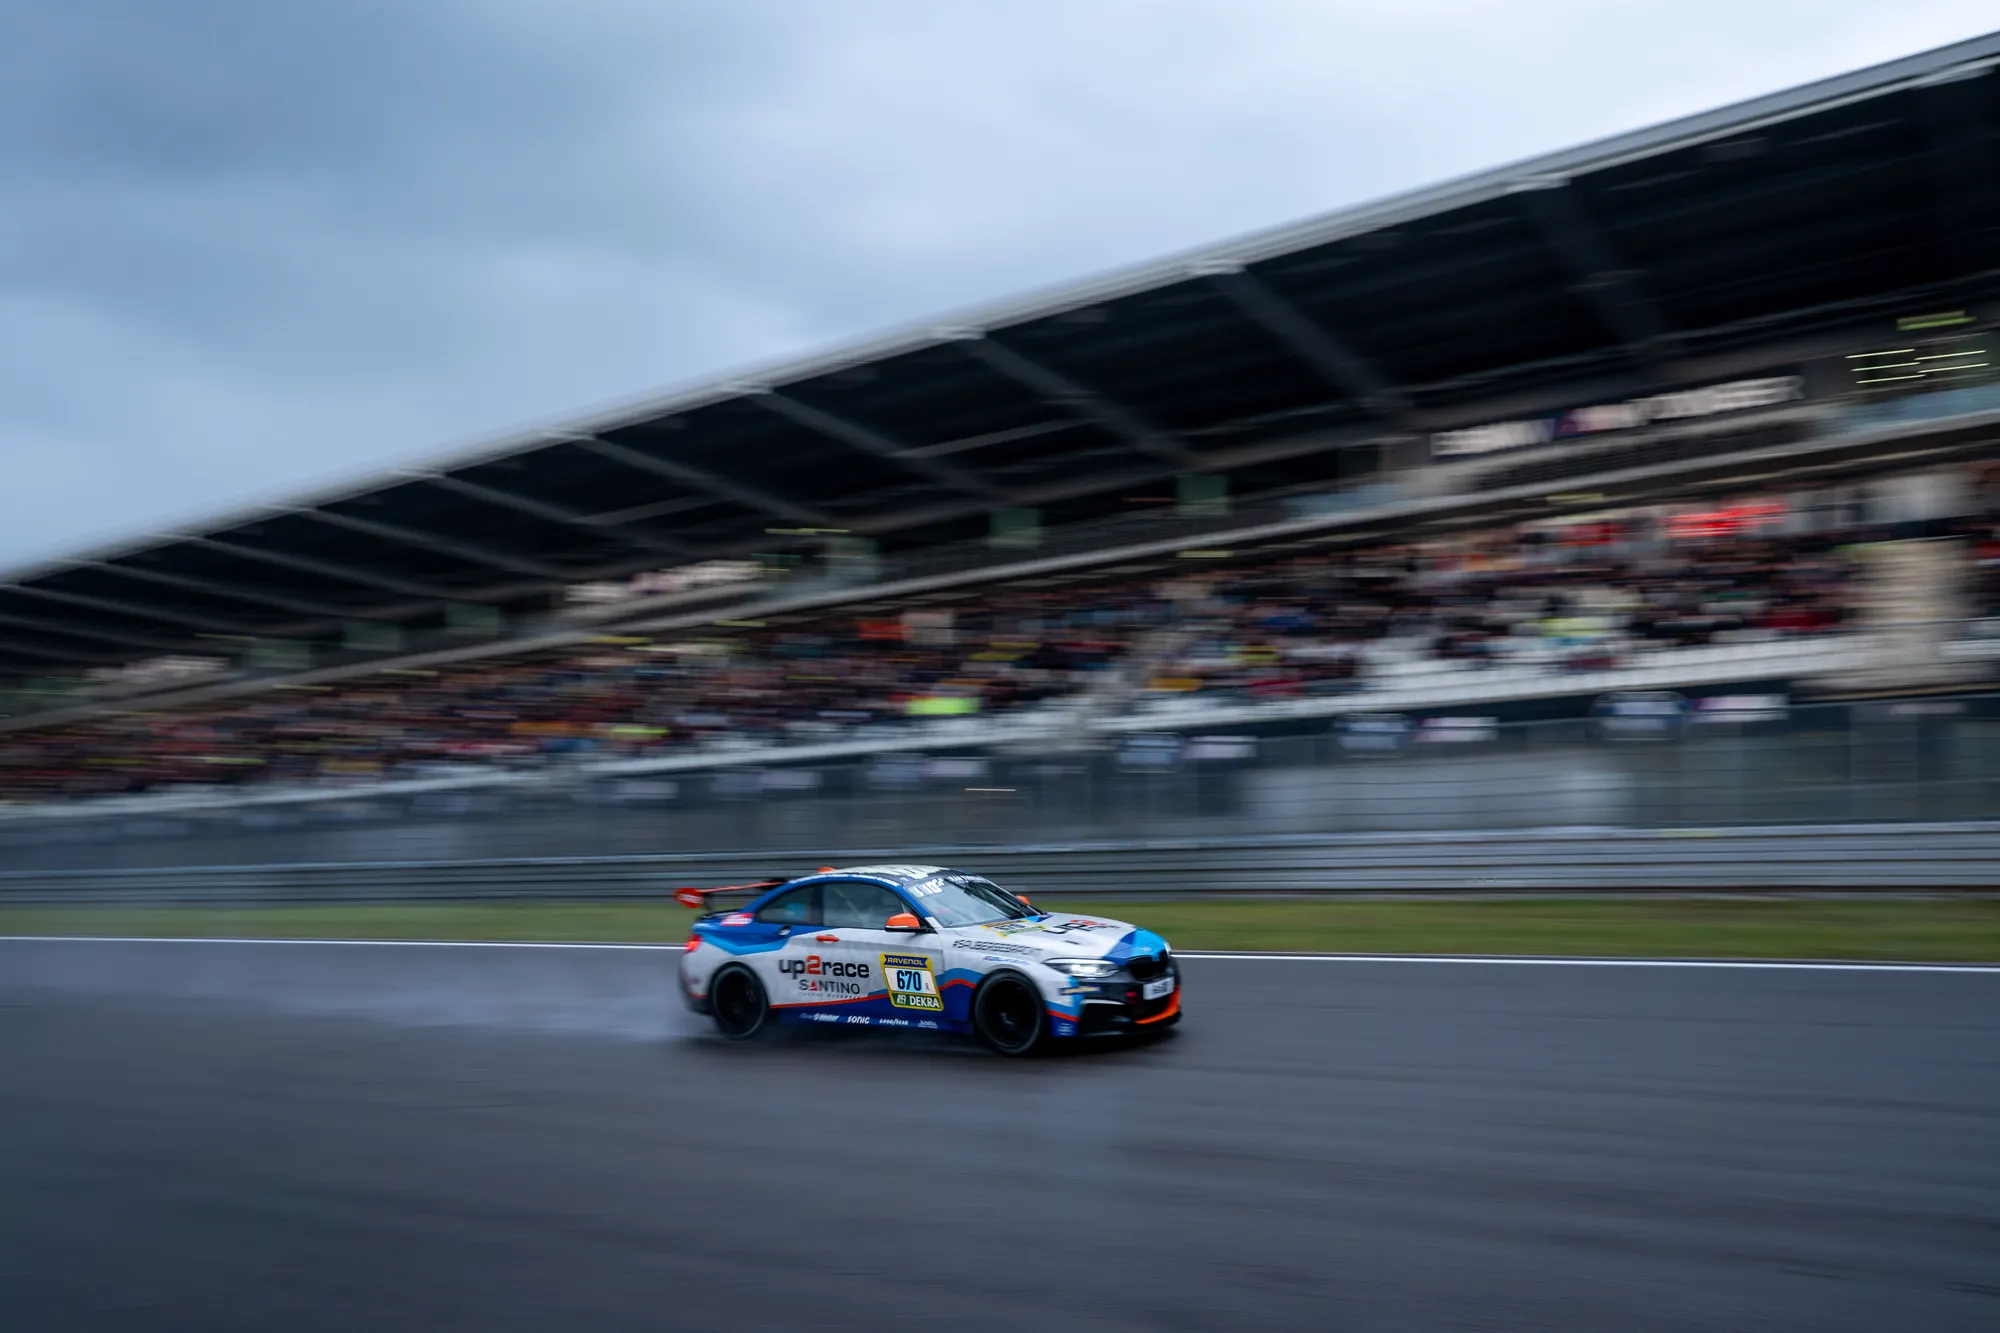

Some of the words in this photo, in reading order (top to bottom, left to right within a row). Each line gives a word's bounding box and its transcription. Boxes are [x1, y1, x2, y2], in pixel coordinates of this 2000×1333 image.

[778, 955, 869, 979] up2race
[887, 957, 924, 965] RAVENOL
[798, 979, 860, 995] SANTINO
[896, 970, 922, 991] 670
[909, 996, 940, 1008] DEKRA
[847, 1015, 870, 1024] SONIC
